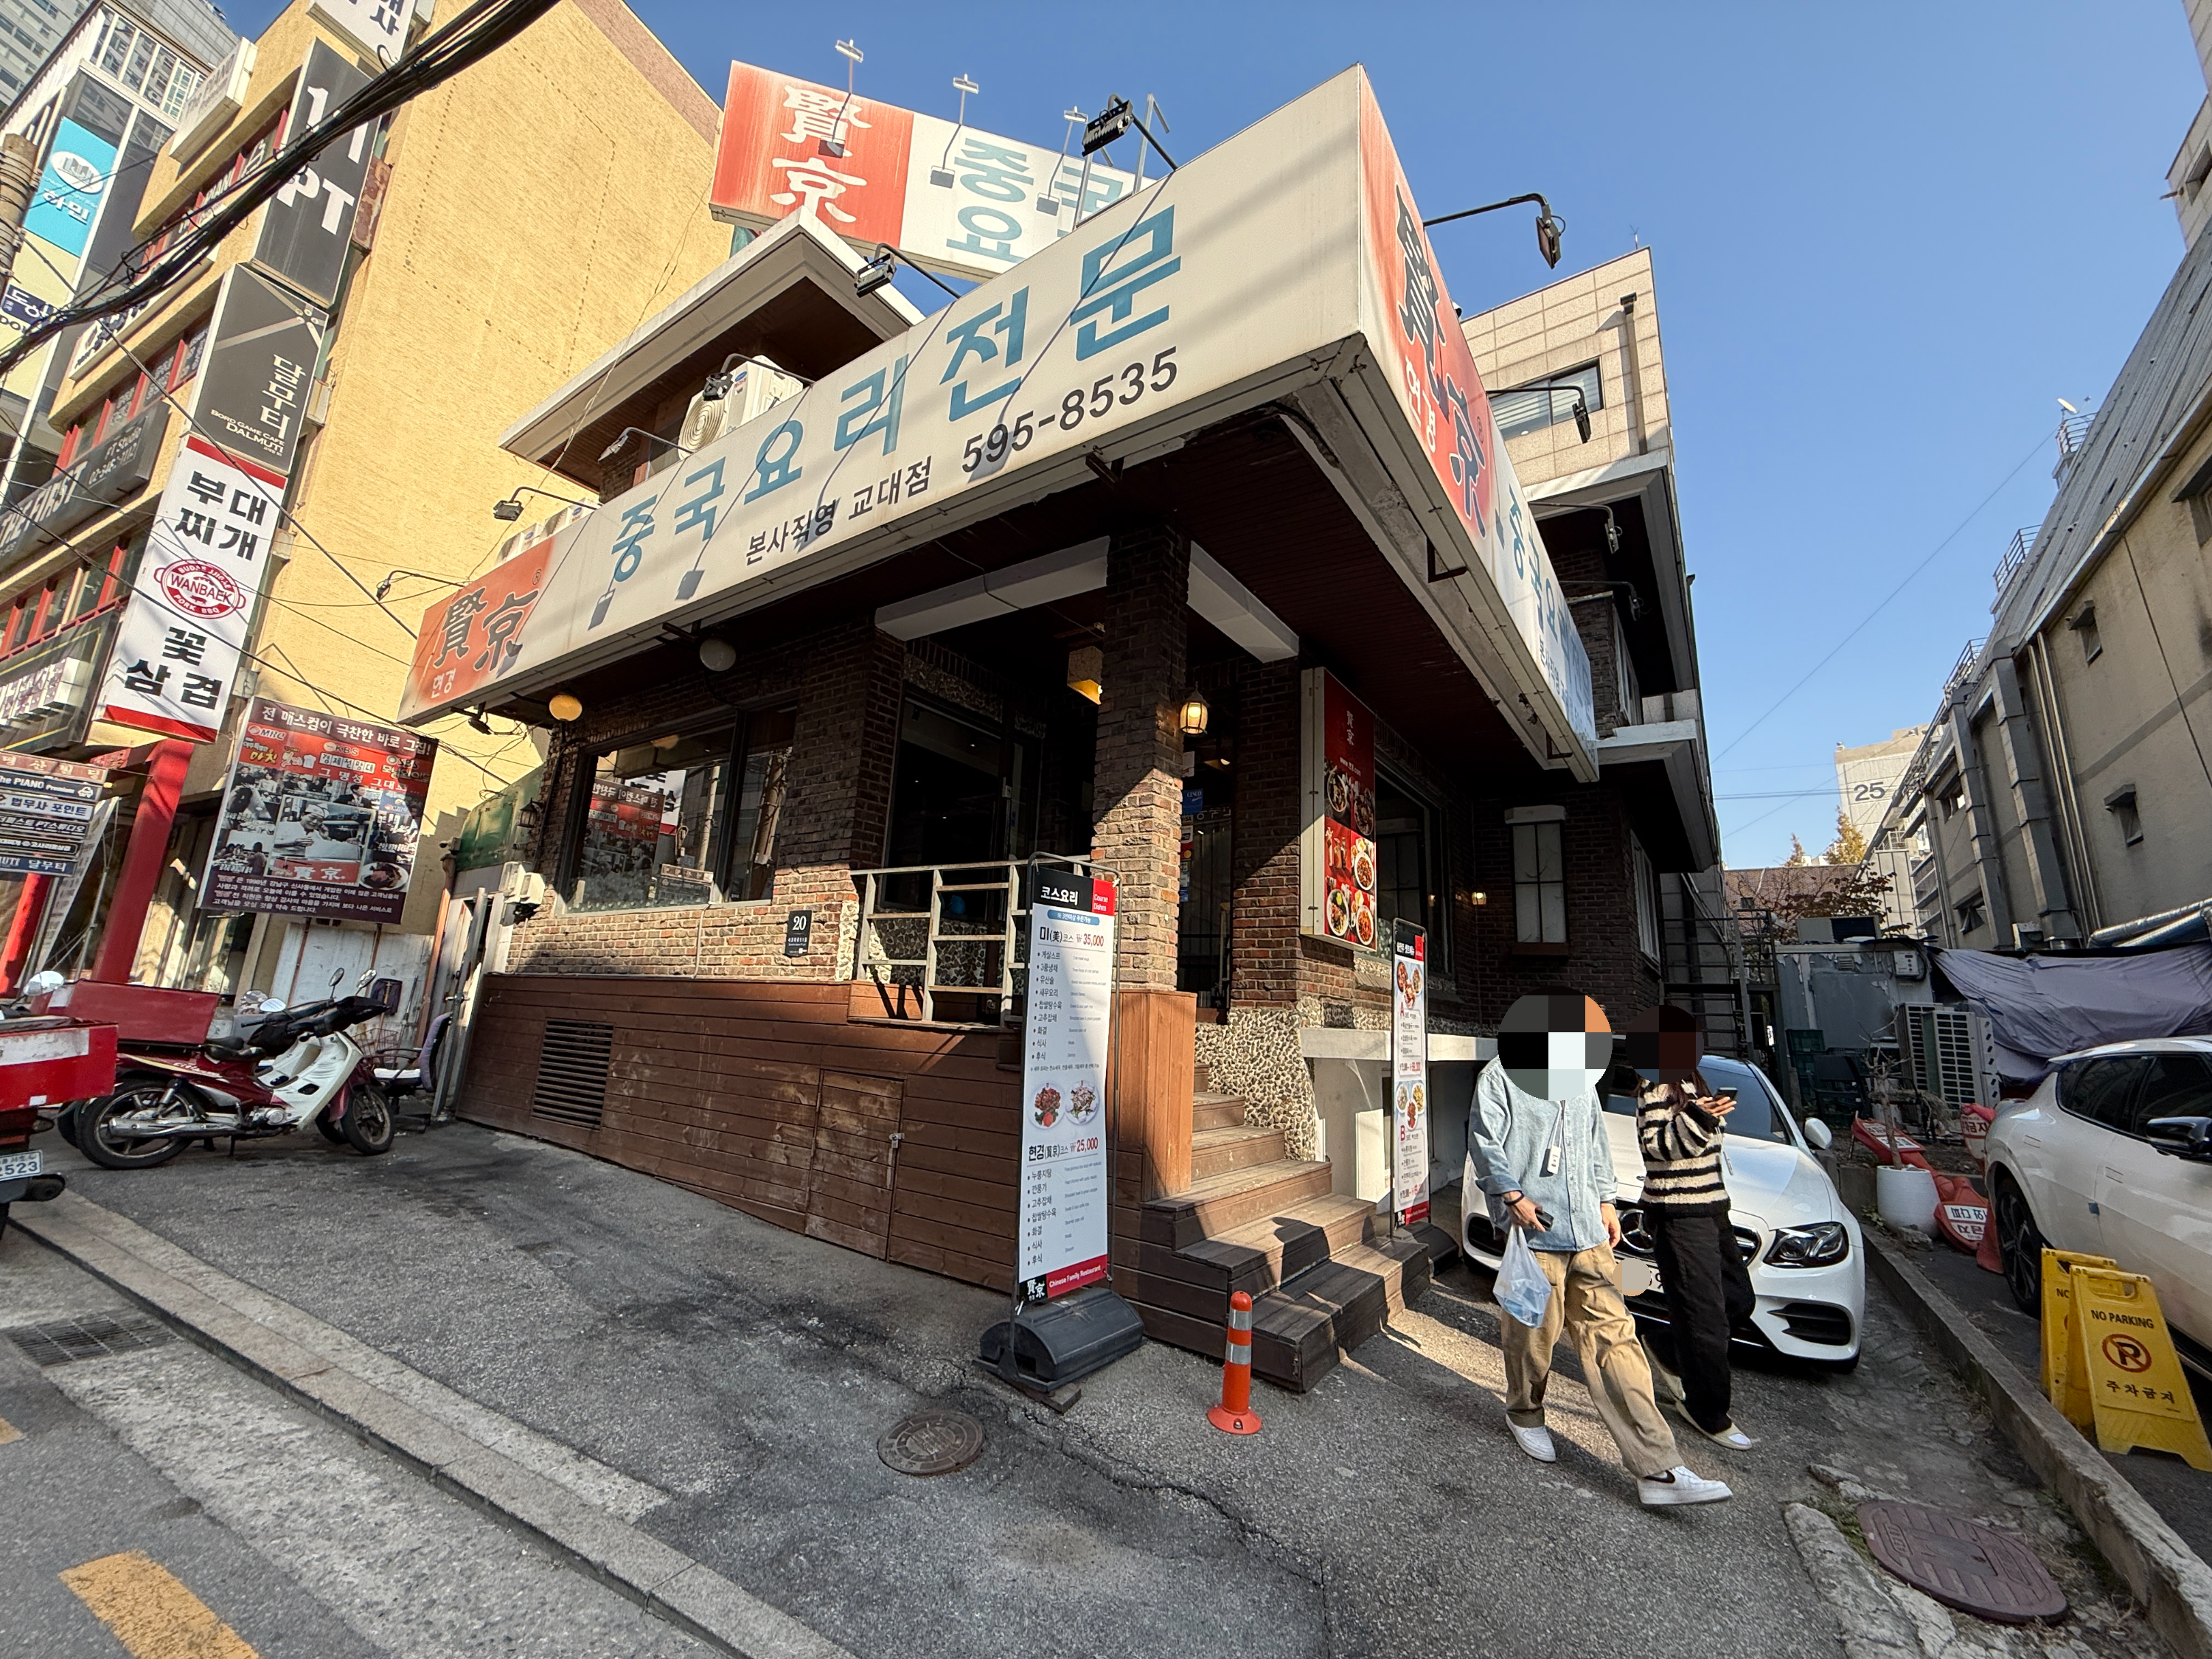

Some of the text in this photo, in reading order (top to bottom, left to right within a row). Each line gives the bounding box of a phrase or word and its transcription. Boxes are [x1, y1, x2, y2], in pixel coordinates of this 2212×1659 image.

[771, 85, 872, 223] 賢京
[276, 165, 355, 235] PT
[260, 354, 306, 439] 달무티
[611, 204, 1181, 582] 중국요리전문
[961, 346, 1178, 473] 595-8535
[1405, 355, 1436, 453] 현경
[211, 409, 285, 446] BORD GAME CAFE
[226, 422, 284, 453] DALMUTI
[187, 470, 268, 526] 부대
[746, 456, 932, 566] 본사직영 교대점
[174, 507, 258, 561] 찌개
[170, 573, 233, 605] WANBAEK
[173, 594, 220, 613] PORK BBQ
[434, 586, 539, 673] 賢京
[161, 626, 207, 667] 꽃
[124, 658, 223, 710] 삼겹
[431, 668, 456, 699] 현경
[262, 706, 276, 722] 전
[281, 710, 333, 734] 매스컴이
[336, 723, 374, 743] 극찬한
[377, 732, 400, 748] 바로
[335, 745, 359, 756] KBS
[319, 768, 331, 777] 그
[322, 754, 375, 772] 경제전망대
[13, 777, 44, 789] PIANO
[1854, 782, 1885, 801] 25
[11, 797, 88, 815] 법무사 포인트
[28, 859, 67, 872] 달무티
[1041, 886, 1078, 905] 코스요리
[1094, 894, 1108, 902] Course
[1094, 903, 1107, 911] Dishes
[793, 916, 807, 931] 20
[1042, 950, 1061, 959] 게살스프
[1040, 975, 1054, 984] 유산슬
[1039, 989, 1058, 997] 새우요리
[1038, 1001, 1062, 1010] 찹쌀탕수육
[1037, 1014, 1057, 1022] 고추잡채
[1037, 1039, 1046, 1048] 식사
[1035, 1051, 1046, 1060] 후식
[1032, 1169, 1051, 1180] 누룽지탕
[1032, 1183, 1047, 1194] 깐풍기
[1032, 1195, 1051, 1208] 고추잡채
[1032, 1208, 1057, 1222] 찹쌀탕수육
[1032, 1239, 1042, 1250] 식사
[1032, 1253, 1043, 1265] 후식
[1049, 1265, 1101, 1287] Chinese Family Restaurant
[1027, 1279, 1046, 1298] 賢京
[2091, 1310, 2154, 1329] NO PARKING
[2107, 1380, 2175, 1404] 주차금지
